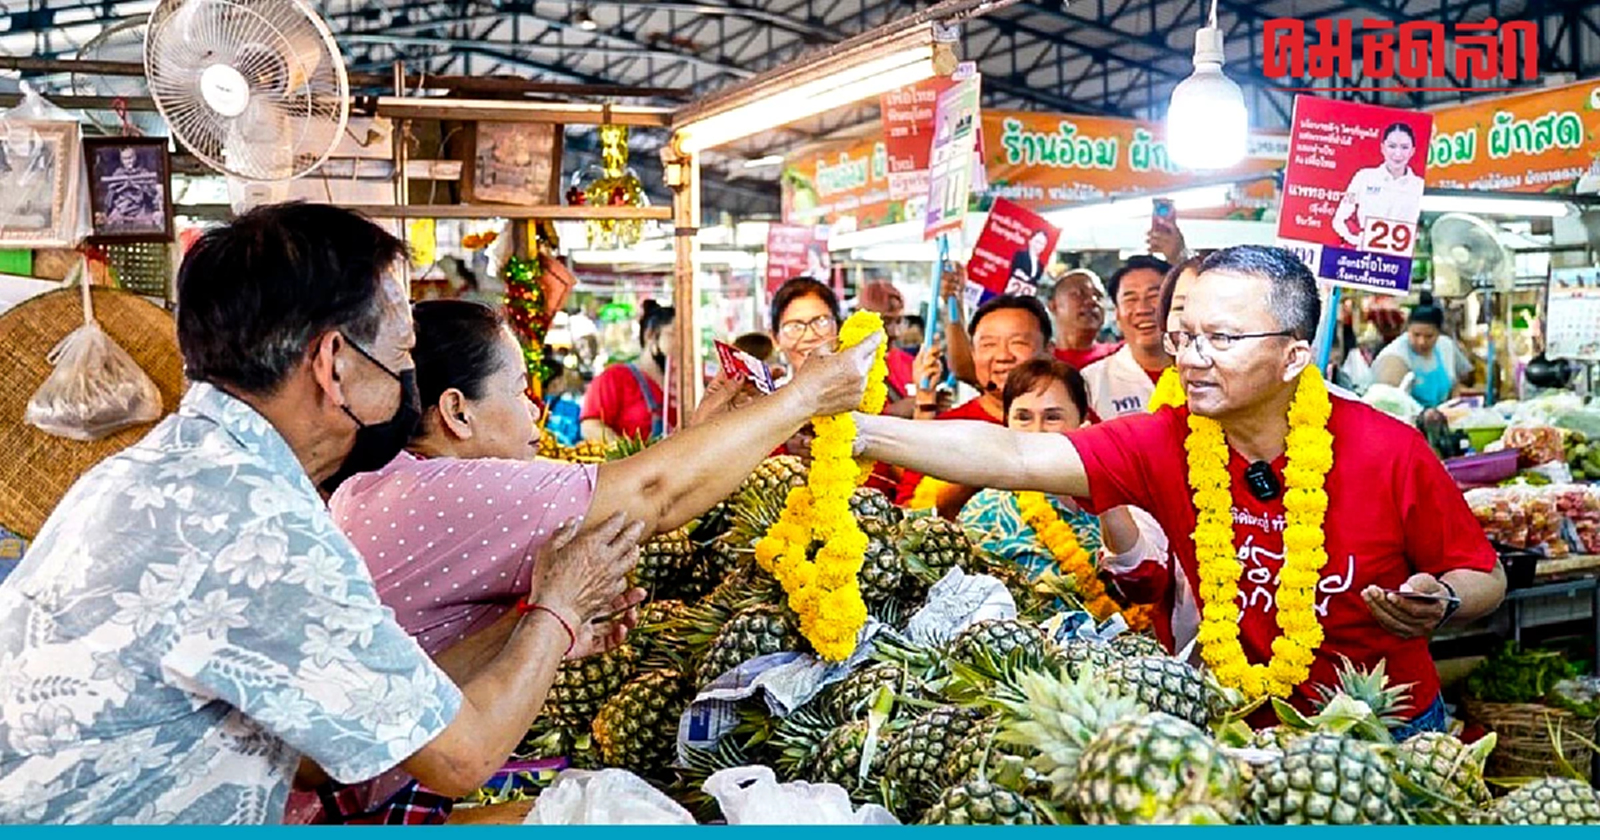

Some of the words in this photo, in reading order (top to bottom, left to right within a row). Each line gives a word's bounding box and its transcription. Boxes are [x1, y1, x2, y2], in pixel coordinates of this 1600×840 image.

[1002, 116, 1117, 171] ร้านอ้อม
[1130, 127, 1180, 172] ผัก
[1489, 110, 1583, 158] ผักสด
[1368, 220, 1411, 251] 29
